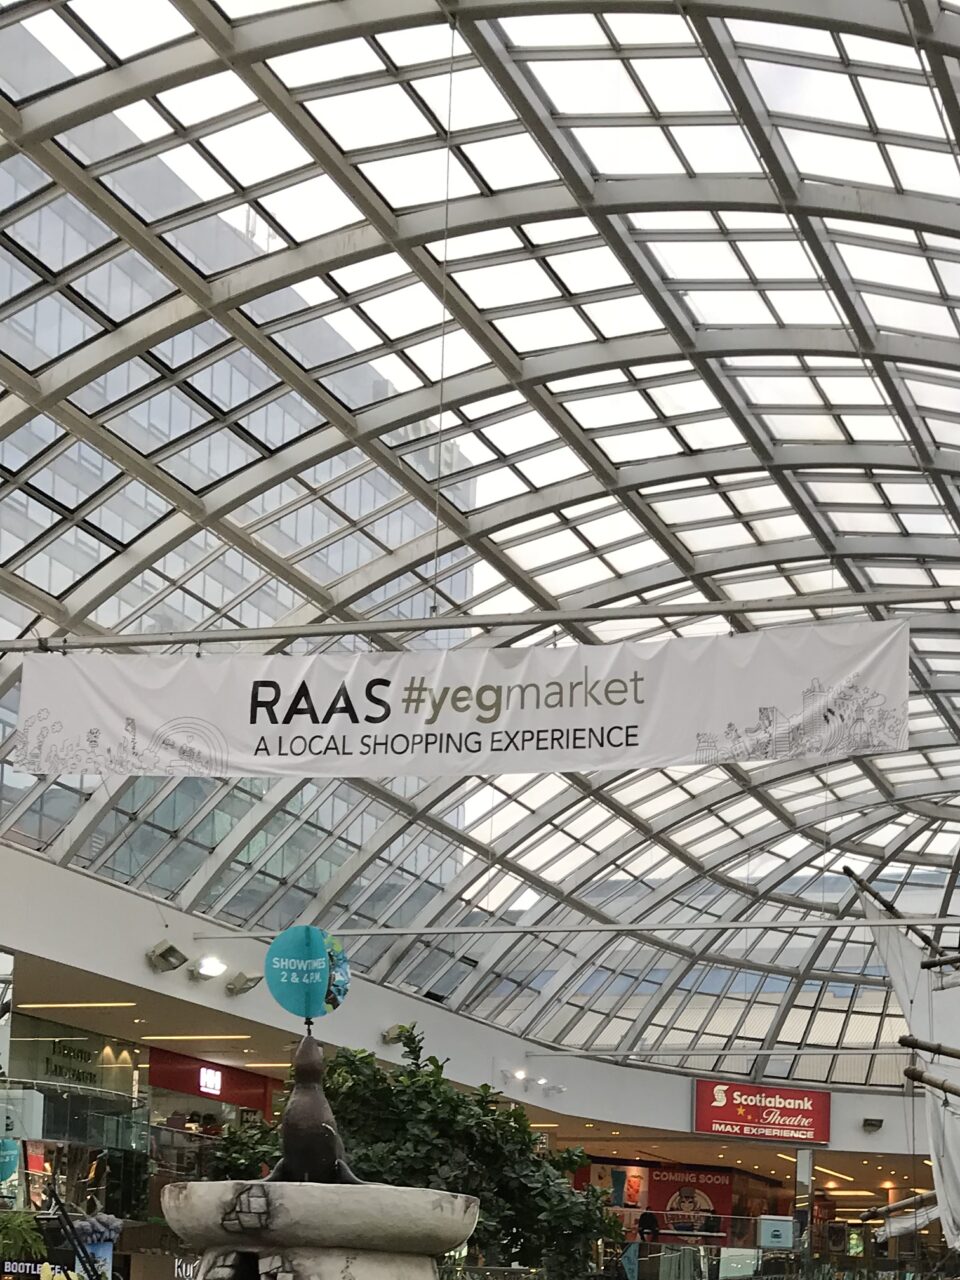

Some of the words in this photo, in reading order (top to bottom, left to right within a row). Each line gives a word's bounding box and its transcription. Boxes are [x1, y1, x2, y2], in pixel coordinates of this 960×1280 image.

[250, 678, 392, 725] RAAS
[401, 665, 645, 725] #yegmarket
[253, 735, 271, 756] A
[277, 734, 353, 756] LOCAL
[359, 731, 482, 756] SHOPPING
[490, 725, 640, 752] EXPERIENCE
[280, 971, 288, 982] 2
[291, 972, 299, 983] &
[302, 973, 309, 984] 4
[733, 1091, 813, 1111] Scotiabank
[760, 1108, 813, 1127] Theatre
[711, 1123, 740, 1133] IMAX
[743, 1126, 815, 1139] EXPERIENCE
[652, 1170, 697, 1183] COMING
[699, 1174, 730, 1186] SOON
